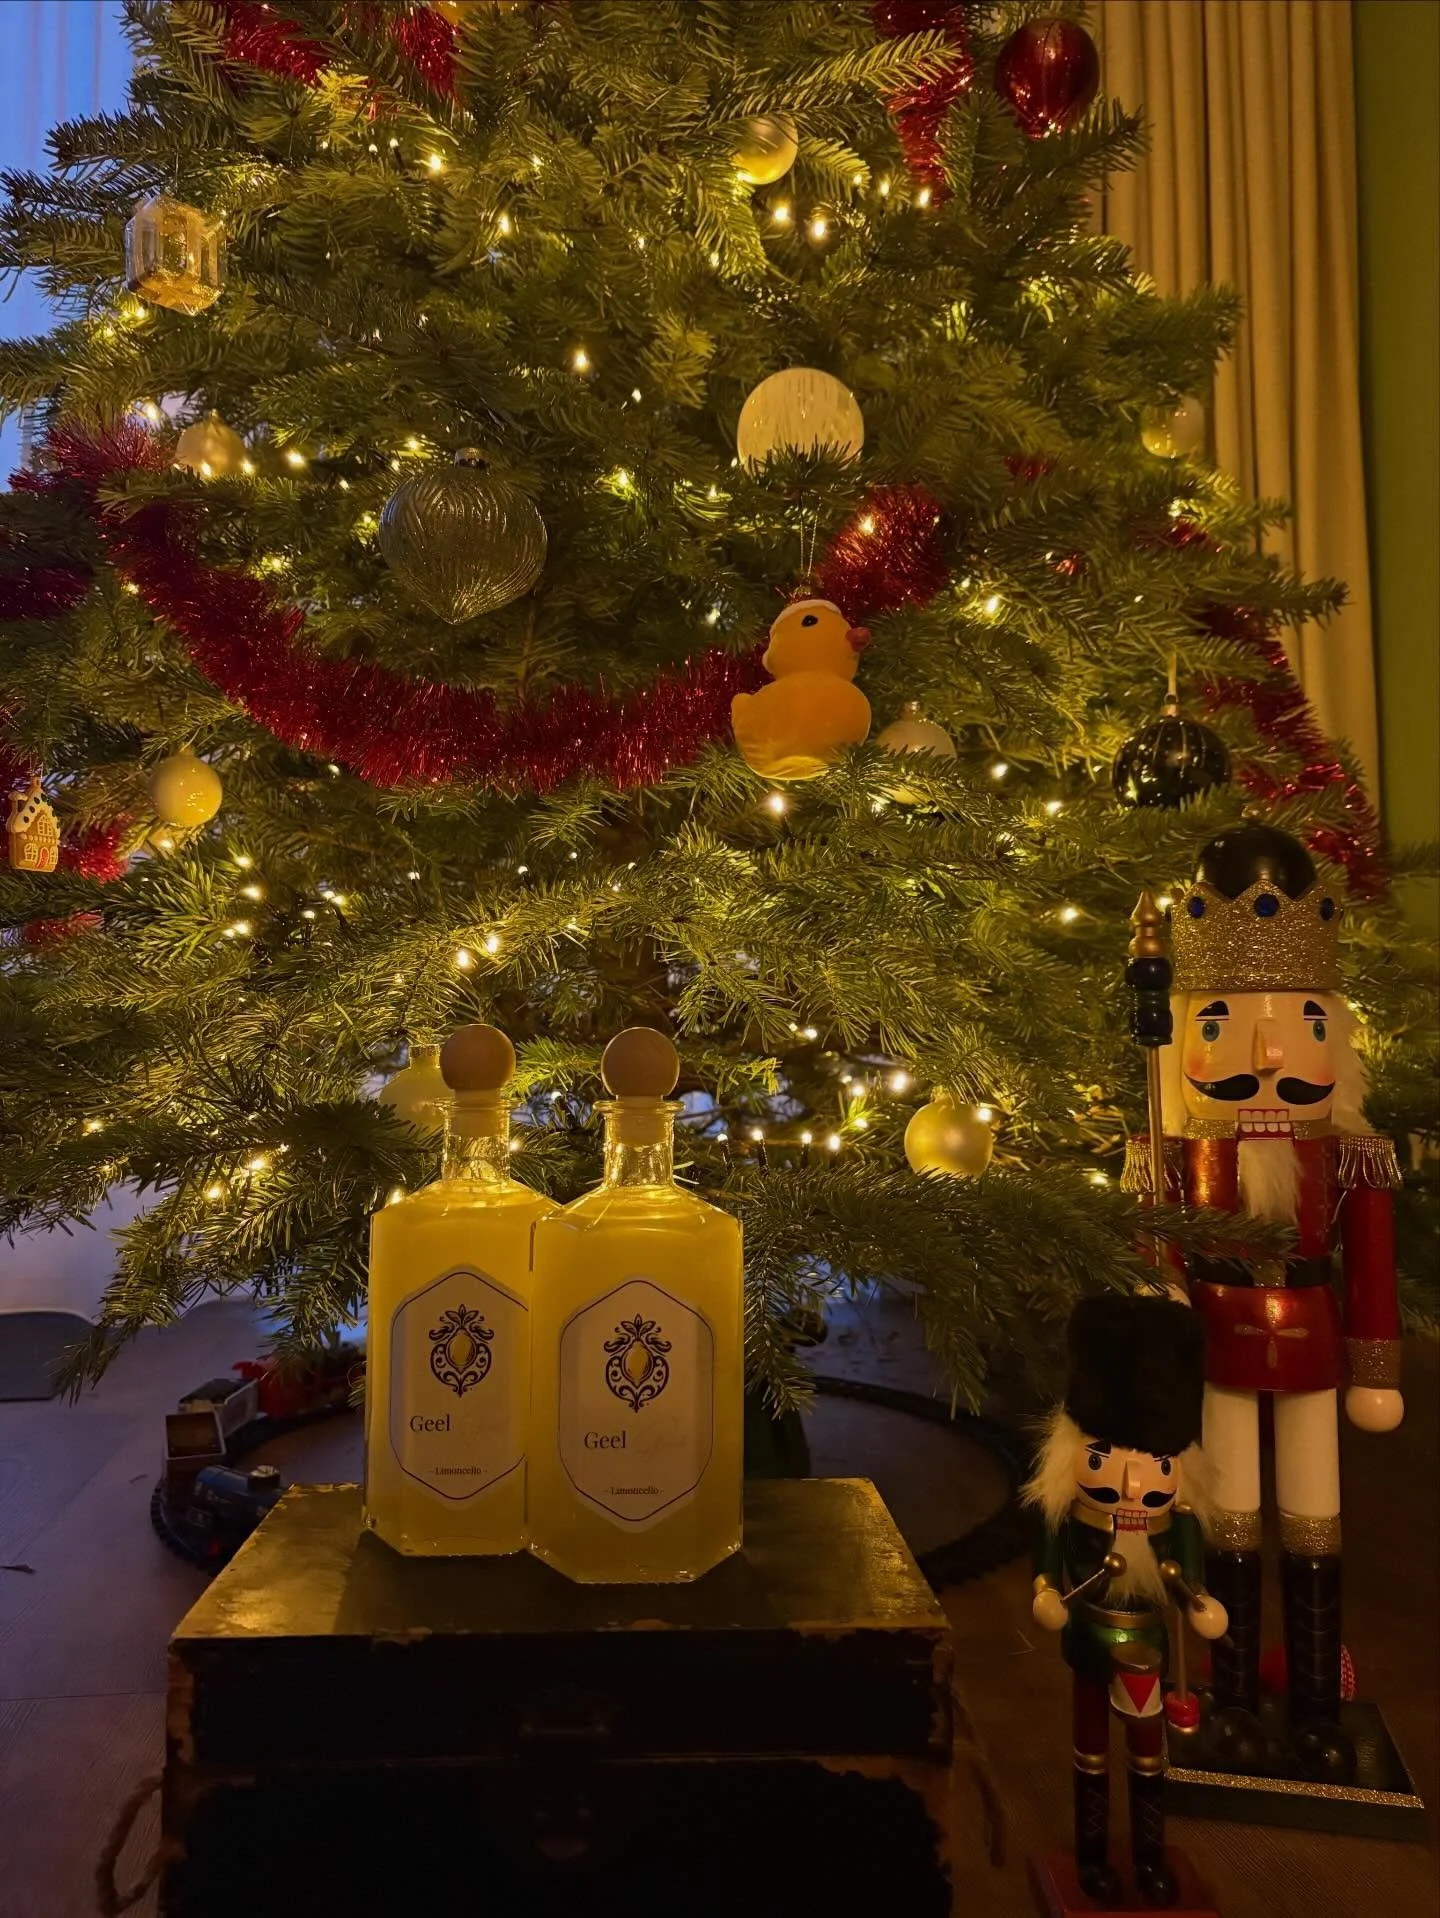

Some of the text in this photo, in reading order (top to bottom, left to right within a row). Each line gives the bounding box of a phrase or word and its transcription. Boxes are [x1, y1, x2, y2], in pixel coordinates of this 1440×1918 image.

[409, 1413, 451, 1432] Geel
[583, 1430, 626, 1449] Geel
[435, 1465, 482, 1475] Limoncello
